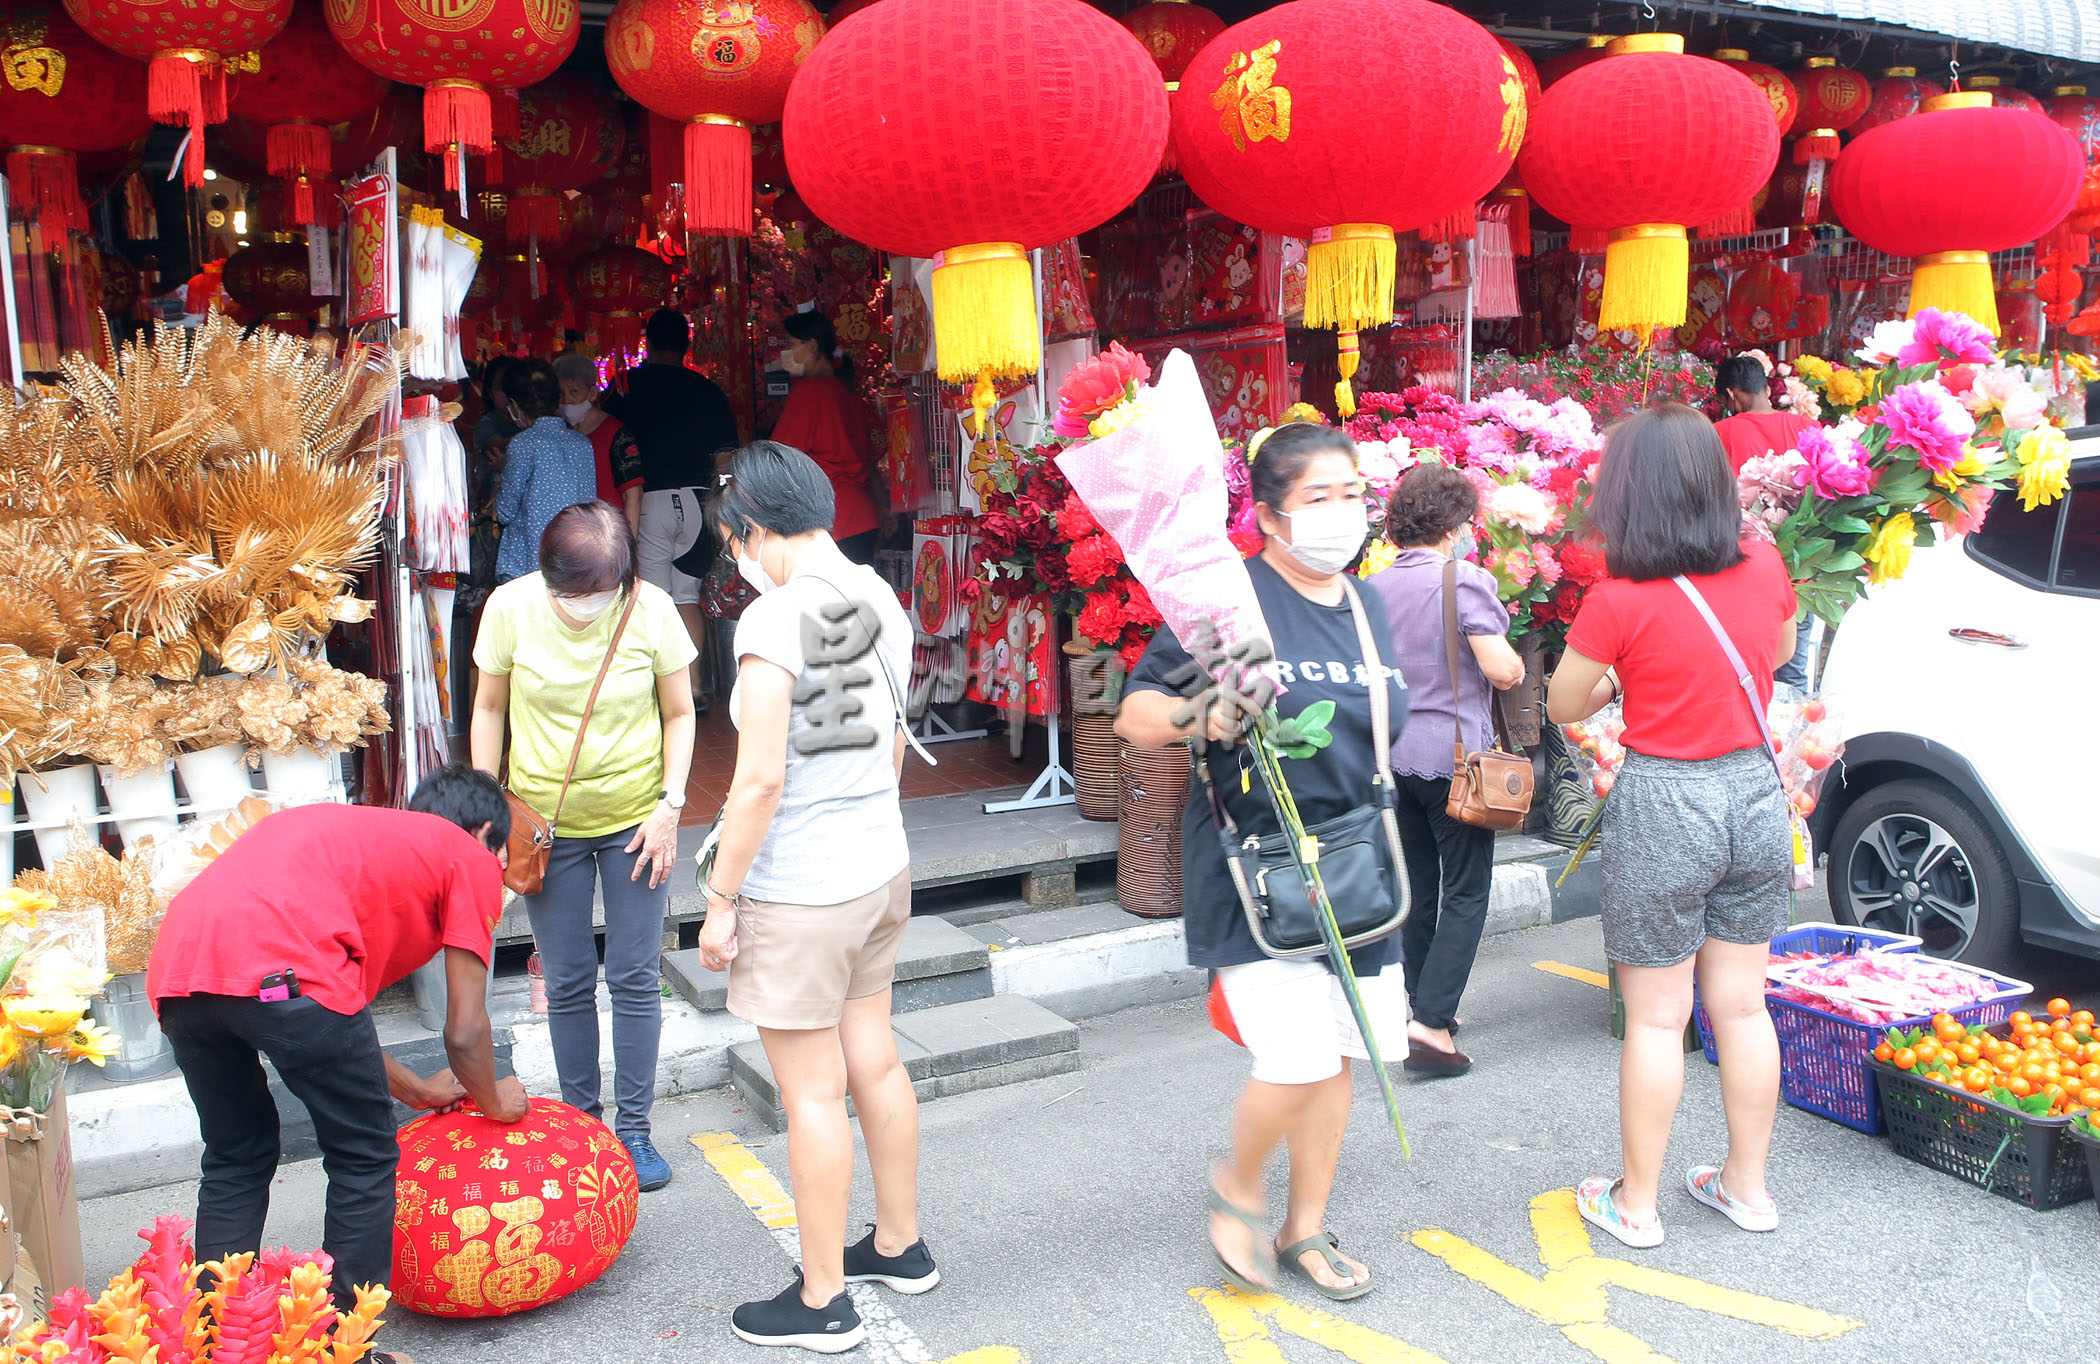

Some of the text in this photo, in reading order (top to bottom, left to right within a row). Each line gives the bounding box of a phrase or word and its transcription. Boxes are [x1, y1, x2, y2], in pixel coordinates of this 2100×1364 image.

[714, 40, 736, 64] 福
[1210, 39, 1292, 152] 福
[1826, 78, 1857, 107] 福
[539, 119, 571, 156] 財
[834, 304, 870, 341] 福
[414, 1156, 438, 1173] 福
[478, 1147, 509, 1170] 福
[521, 1155, 544, 1174] 福
[547, 1152, 568, 1170] 福
[438, 1163, 457, 1181] 福
[462, 1182, 482, 1201] 福
[498, 1180, 520, 1196] 福
[541, 1178, 563, 1200] 福
[429, 1197, 448, 1218] 福
[430, 1231, 450, 1251] 福
[545, 1218, 577, 1249] 福
[433, 1195, 564, 1309] 福
